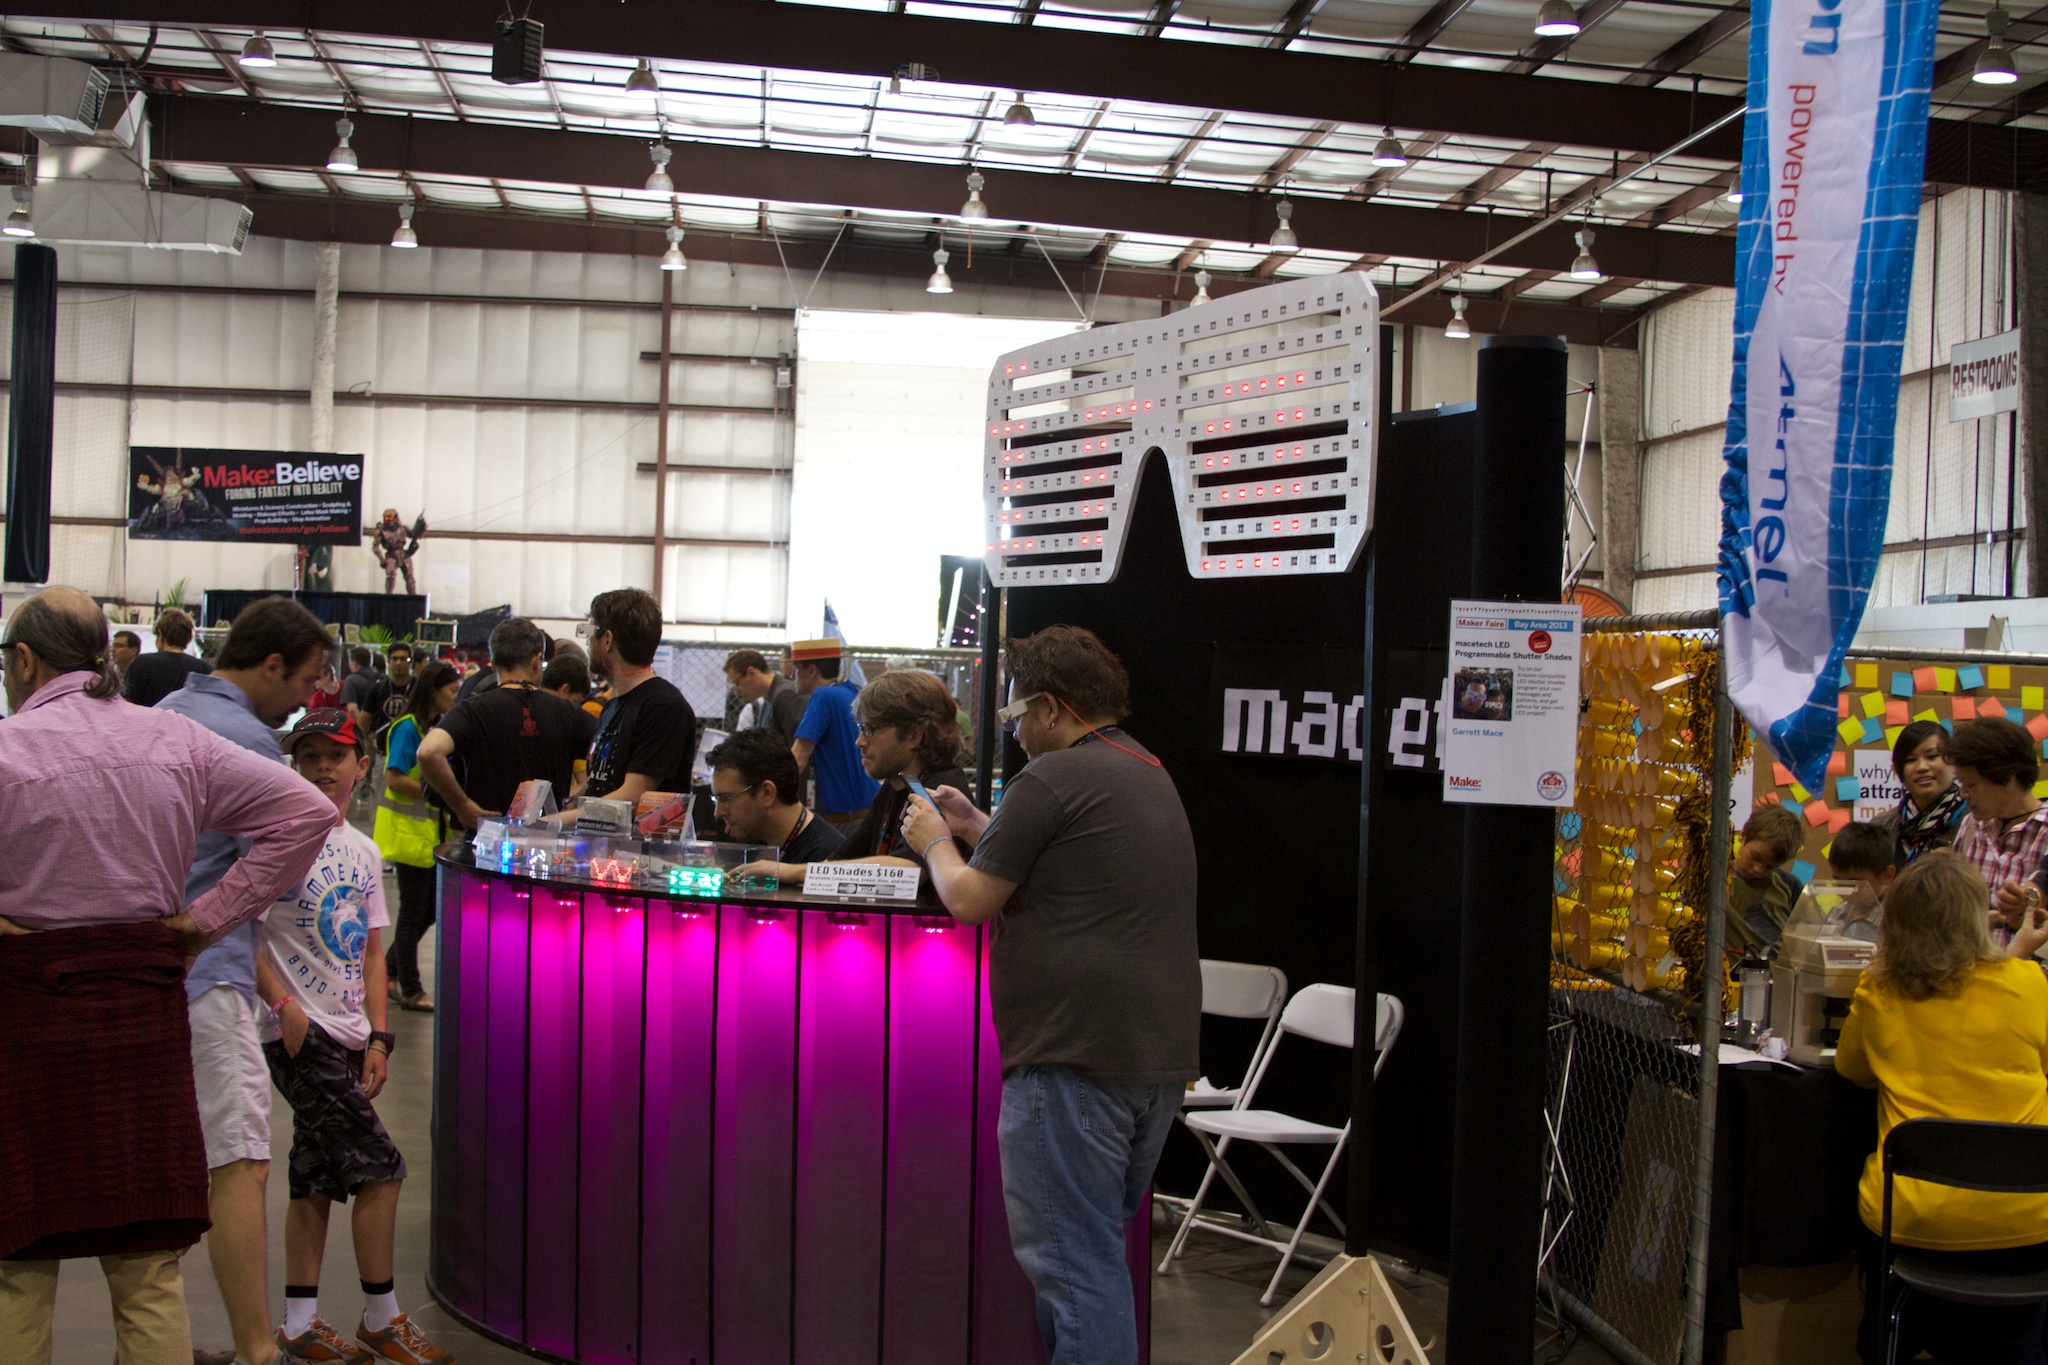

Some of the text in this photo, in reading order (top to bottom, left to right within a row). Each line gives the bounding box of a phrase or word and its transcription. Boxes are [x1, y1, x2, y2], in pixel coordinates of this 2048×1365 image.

[1775, 84, 1817, 242] powered
[1953, 350, 2018, 399] RESTROOMS
[225, 481, 344, 500] FORGING FANTASY INTO REALITY
[239, 524, 350, 535] makezine.com/go/believe
[1458, 620, 1505, 628] Maker Faire
[1514, 620, 1568, 630] Bay Area 2013
[1455, 640, 1493, 648] macetech
[1455, 650, 1511, 660] Programmable
[1452, 728, 1481, 736] Garrett
[1860, 764, 1892, 784] why
[1449, 776, 1482, 788] Make:
[1860, 784, 1902, 799] attra
[810, 866, 830, 875] LED
[833, 866, 872, 877] Shades
[876, 868, 904, 878] $160
